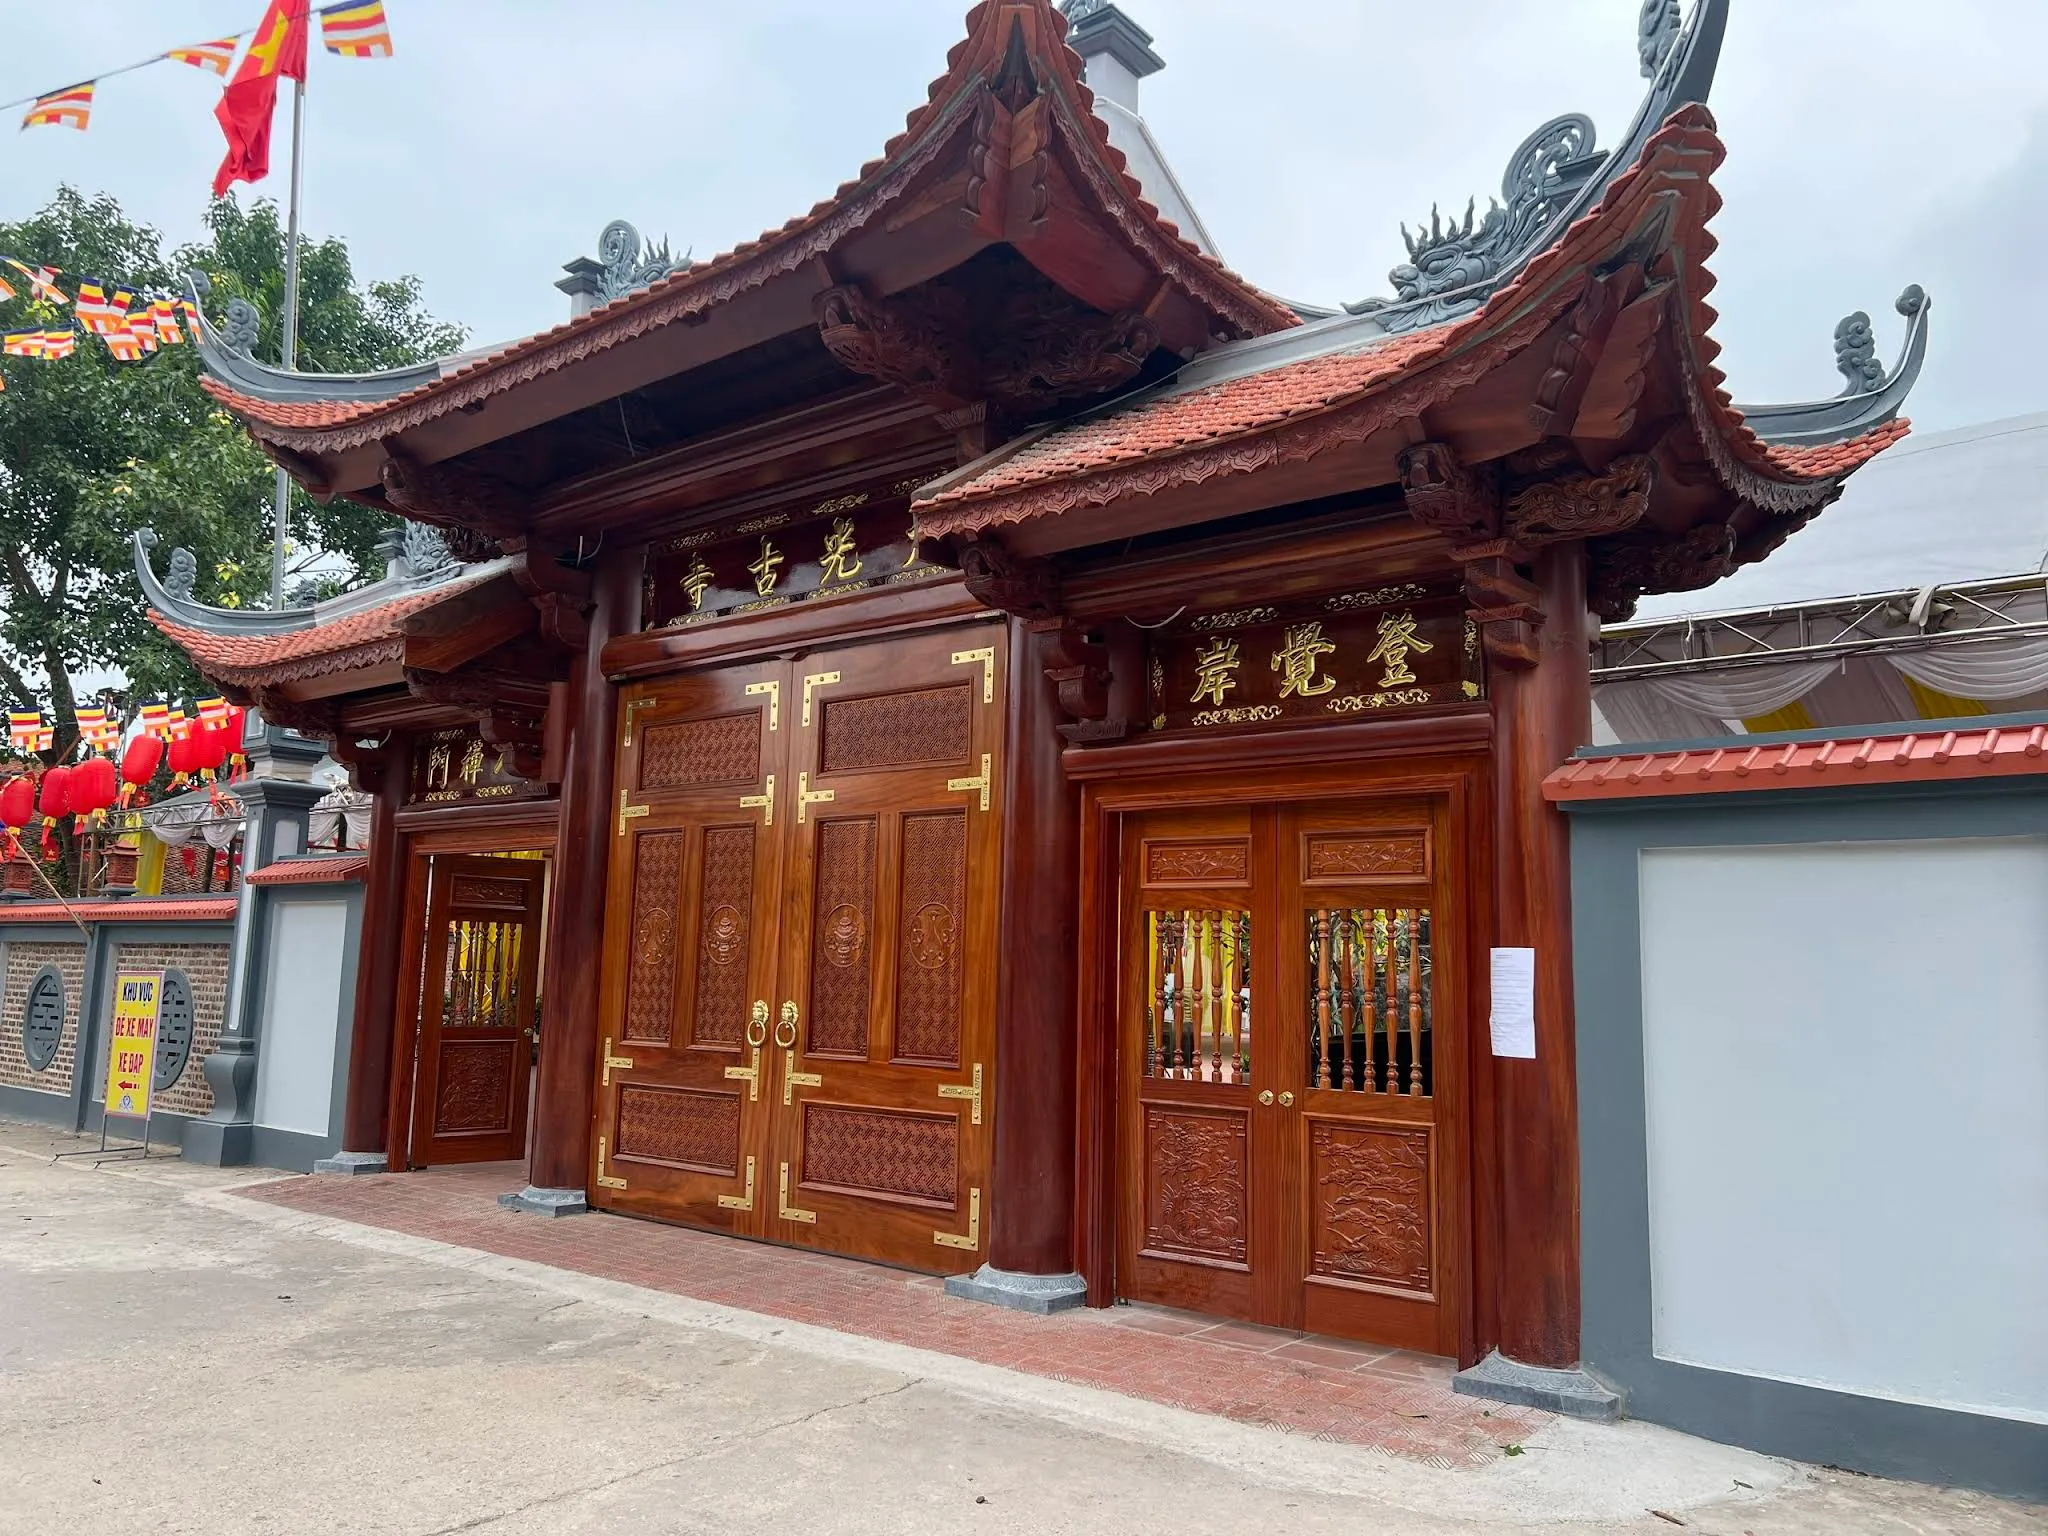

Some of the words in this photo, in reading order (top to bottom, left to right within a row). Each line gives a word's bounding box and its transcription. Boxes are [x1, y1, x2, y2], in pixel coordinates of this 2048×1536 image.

[122, 982, 138, 1001] KHU
[139, 981, 154, 1007] VỰC
[125, 1016, 136, 1037] XE
[118, 1051, 128, 1073] XE
[128, 1053, 144, 1078] ĐẠP
